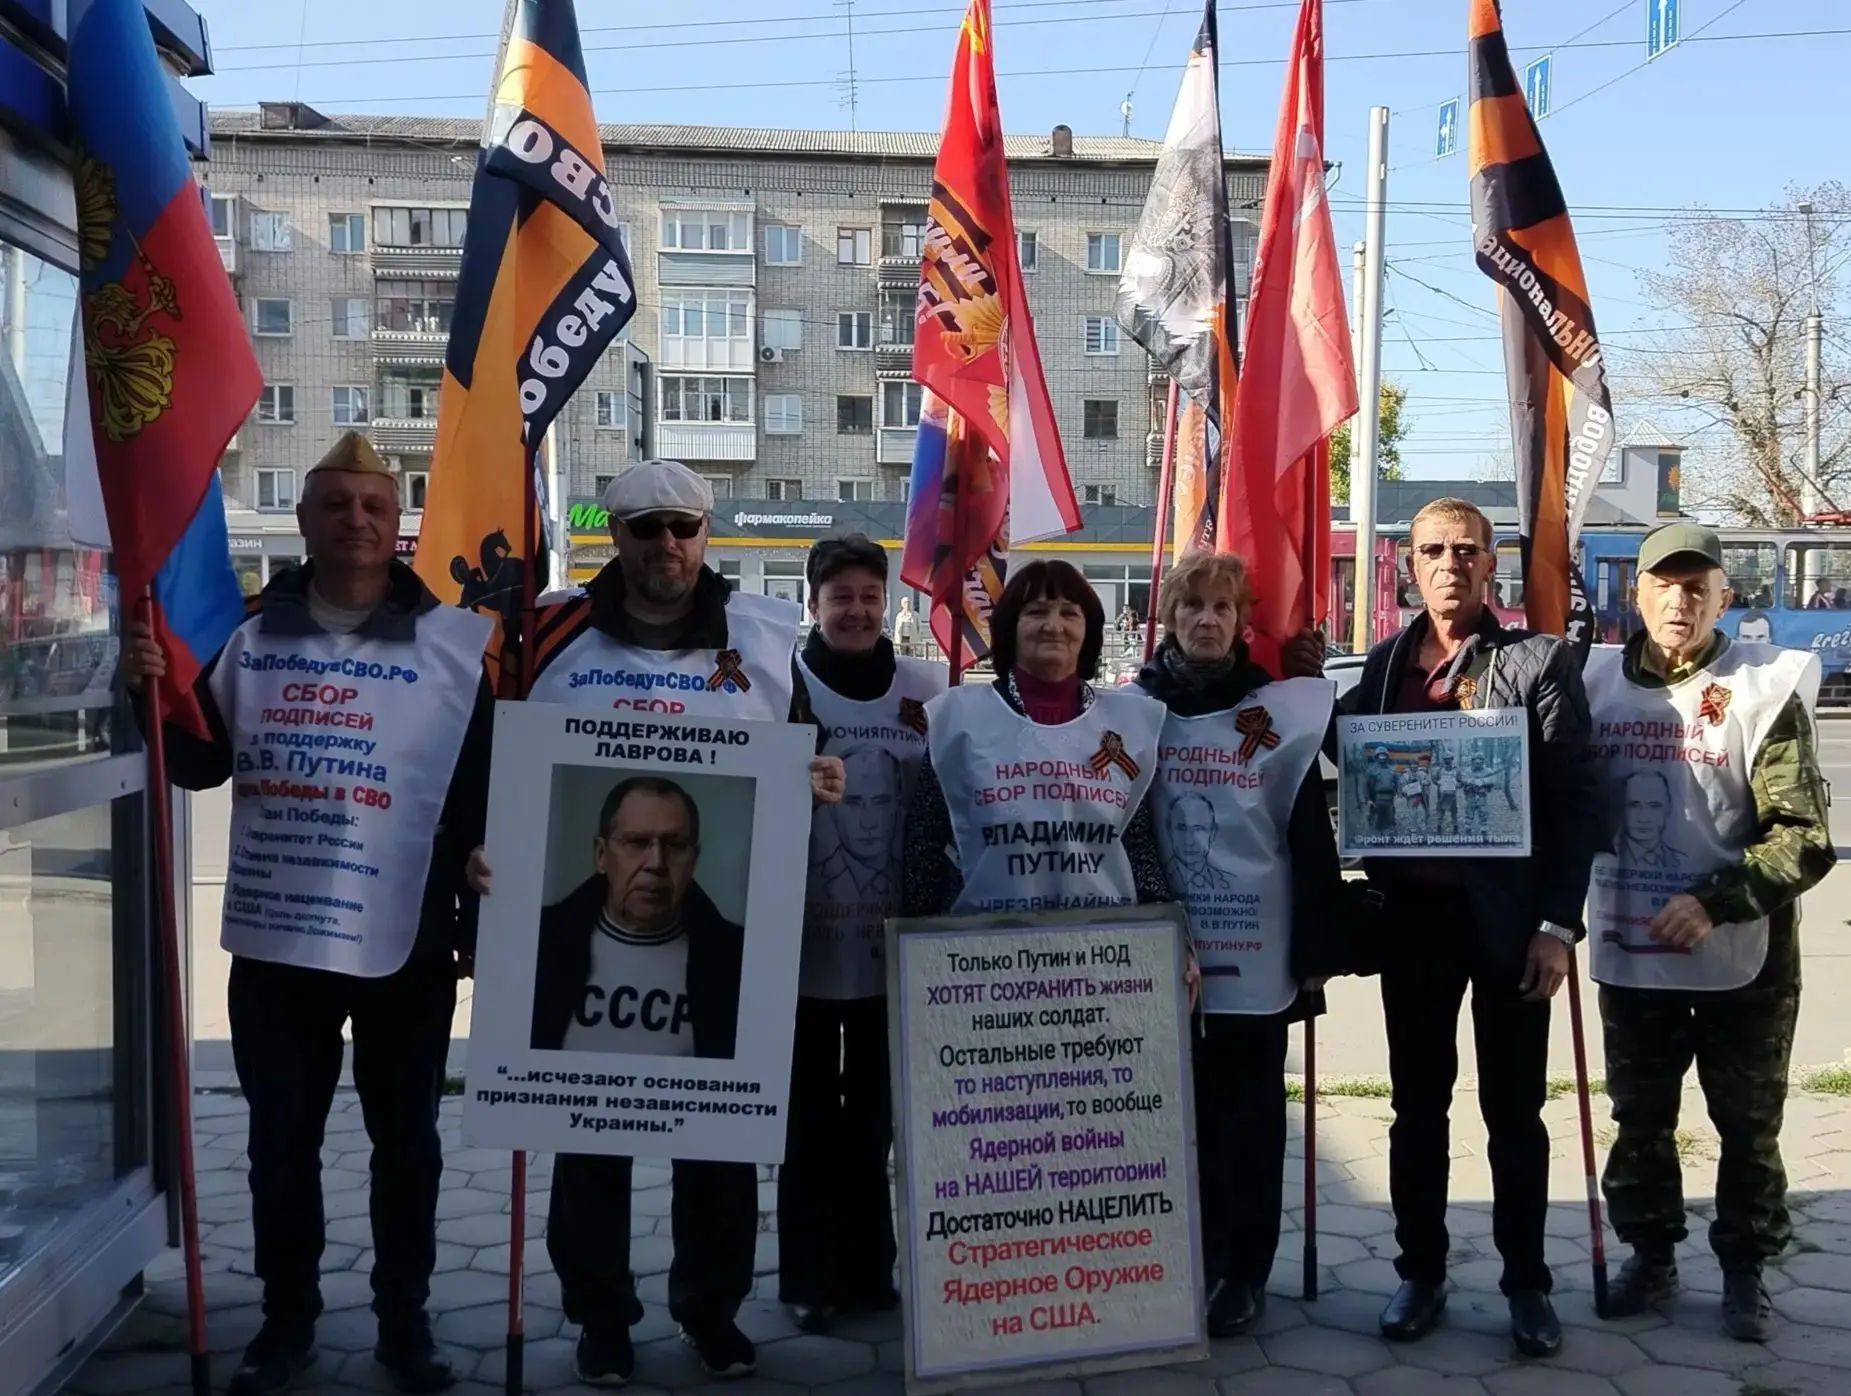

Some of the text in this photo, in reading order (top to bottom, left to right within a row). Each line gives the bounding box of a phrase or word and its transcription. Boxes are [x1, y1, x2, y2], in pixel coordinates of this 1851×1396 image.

[508, 120, 619, 229] СВО
[520, 259, 632, 414] обеду
[735, 512, 832, 526] фармакопейка
[282, 683, 358, 705] СБОР
[568, 669, 737, 694] ЗаПобедувСВО.Ф
[261, 709, 374, 731] ПОДПИСЕЙ
[565, 718, 750, 746] ПОДДЕРЖИВАЮ
[1350, 714, 1518, 734] ЗА СУВЕРЕНИТЕТ РОССИИ!
[1600, 721, 1704, 741] НАРОДНЫЙ
[264, 732, 376, 756] поддержку
[595, 742, 703, 764] ЛАВРОВА
[1624, 744, 1729, 767] ПОДПИСЕЙ
[236, 749, 387, 783] В.В. Путина
[334, 787, 346, 800] в
[352, 785, 392, 810] СВО
[287, 807, 359, 827] Победы:
[317, 833, 364, 851] России
[1427, 832, 1484, 846] решения
[1007, 851, 1104, 876] ПУТИНУ
[1213, 894, 1260, 905] НАРОДА
[948, 944, 1131, 973] Только Путин и НОД
[927, 977, 1153, 1006] ХОТЯТ СОХРАНИТЬ жизни
[971, 1006, 1110, 1030] наших солдат.
[940, 1034, 1144, 1068] Остальные требуют
[643, 1076, 761, 1095] основания
[955, 1066, 1133, 1096] то наступления, то
[477, 1089, 777, 1117] признания независимости
[1092, 1093, 1162, 1114] вообще
[970, 1130, 1124, 1162] Ядерной войны
[935, 1158, 1167, 1199] на НАШЕЙ территории!
[927, 1193, 1173, 1240] Достаточно НАЦЕЛИТЬ
[948, 1227, 1152, 1268] Стратегическое
[943, 1263, 1164, 1304] Ядерное Оружие
[992, 1302, 1101, 1335] на США.
